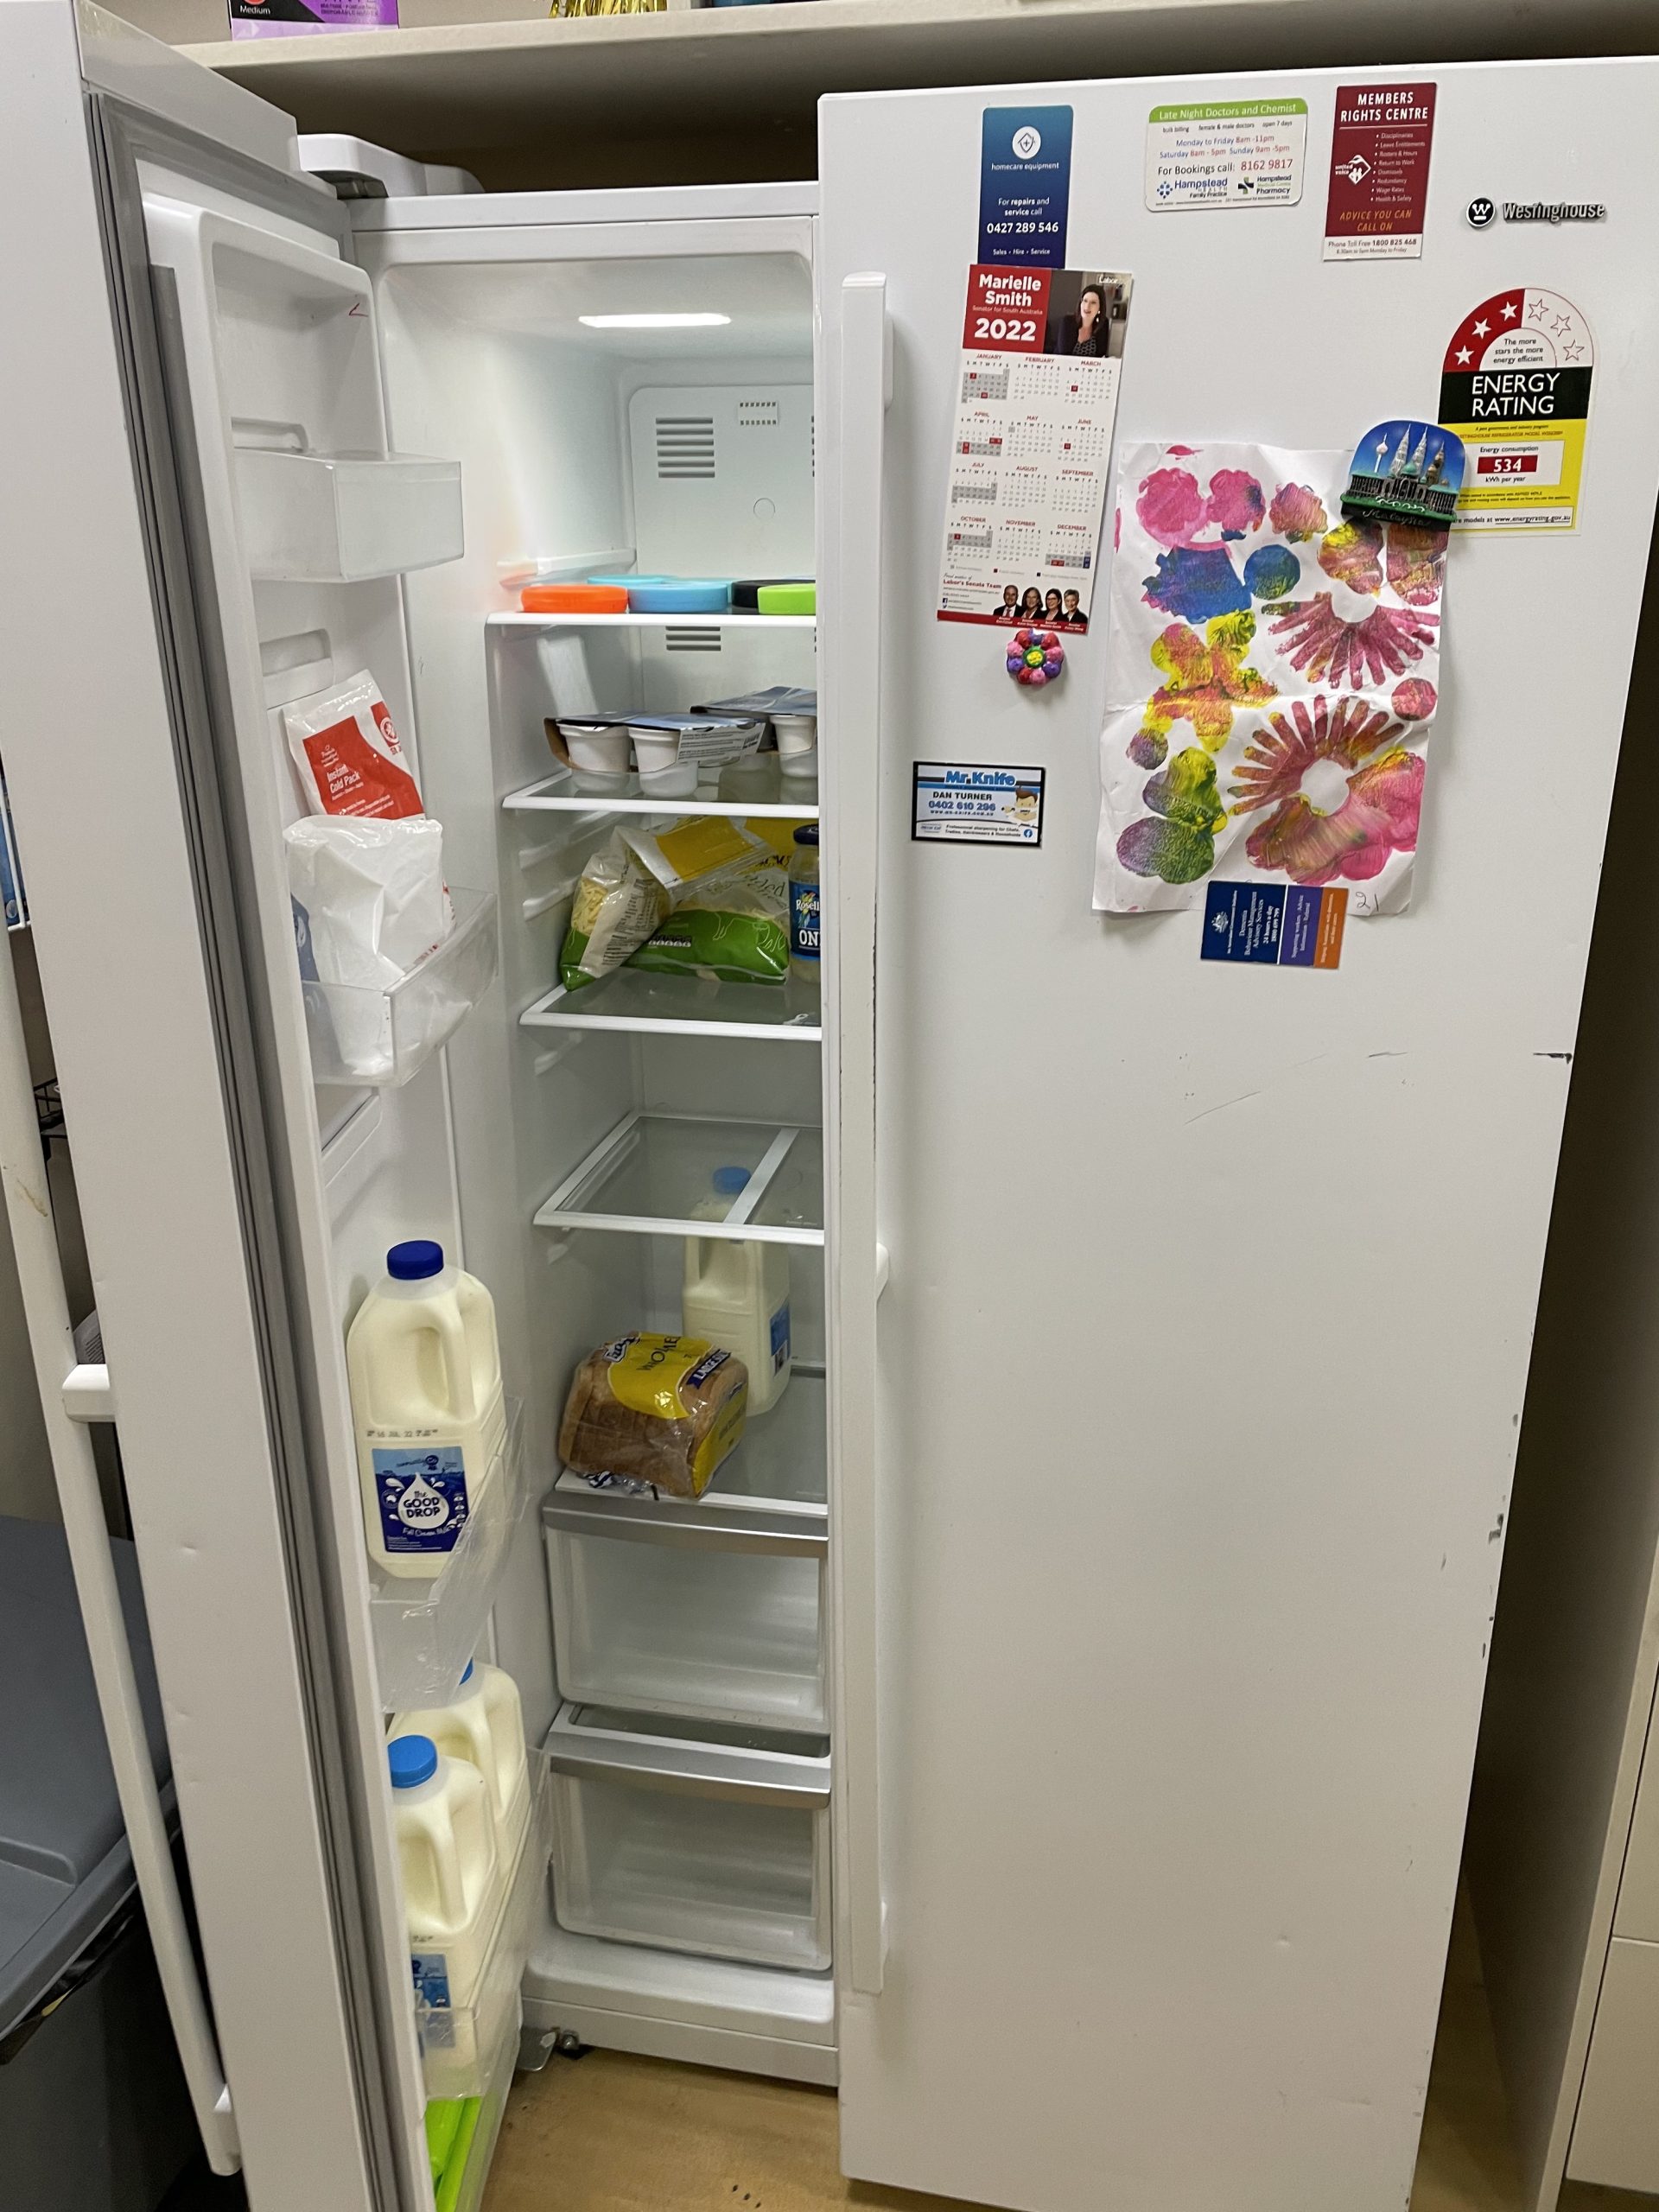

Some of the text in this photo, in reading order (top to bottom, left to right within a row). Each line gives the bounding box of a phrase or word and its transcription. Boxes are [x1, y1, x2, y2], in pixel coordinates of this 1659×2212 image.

[240, 5, 270, 15] Medium
[1357, 92, 1414, 105] MEMBERS
[1160, 104, 1296, 120] Late Night Doctors and Chemist
[1341, 107, 1428, 123] RIGHTS CENTRE
[1025, 162, 1059, 171] equipment
[1175, 164, 1215, 175] Bookings
[1217, 162, 1235, 173] call:
[1241, 160, 1265, 171] 8162
[1268, 159, 1293, 169] 9817
[1175, 178, 1228, 190] Hampstead
[1011, 198, 1035, 207] repairs
[1339, 209, 1412, 220] ADVICE YOU CAN
[1503, 202, 1605, 222] Westinghouse
[987, 222, 1058, 233] 0427 289 546
[1357, 222, 1393, 232] CALL ON
[979, 274, 1041, 291] Marielle
[985, 291, 1032, 307] Smith
[975, 318, 1037, 341] 2022
[1493, 356, 1516, 365] energy
[1472, 373, 1560, 395] ENERGY
[1472, 397, 1554, 416] RATING
[1493, 458, 1522, 473] 534
[327, 764, 349, 782] Instant
[330, 779, 344, 793] Cold
[344, 771, 360, 785] Pack
[796, 899, 819, 911] Rosell
[799, 930, 820, 945] ON
[404, 1497, 440, 1508] GOOD
[406, 1507, 441, 1518] DROP
